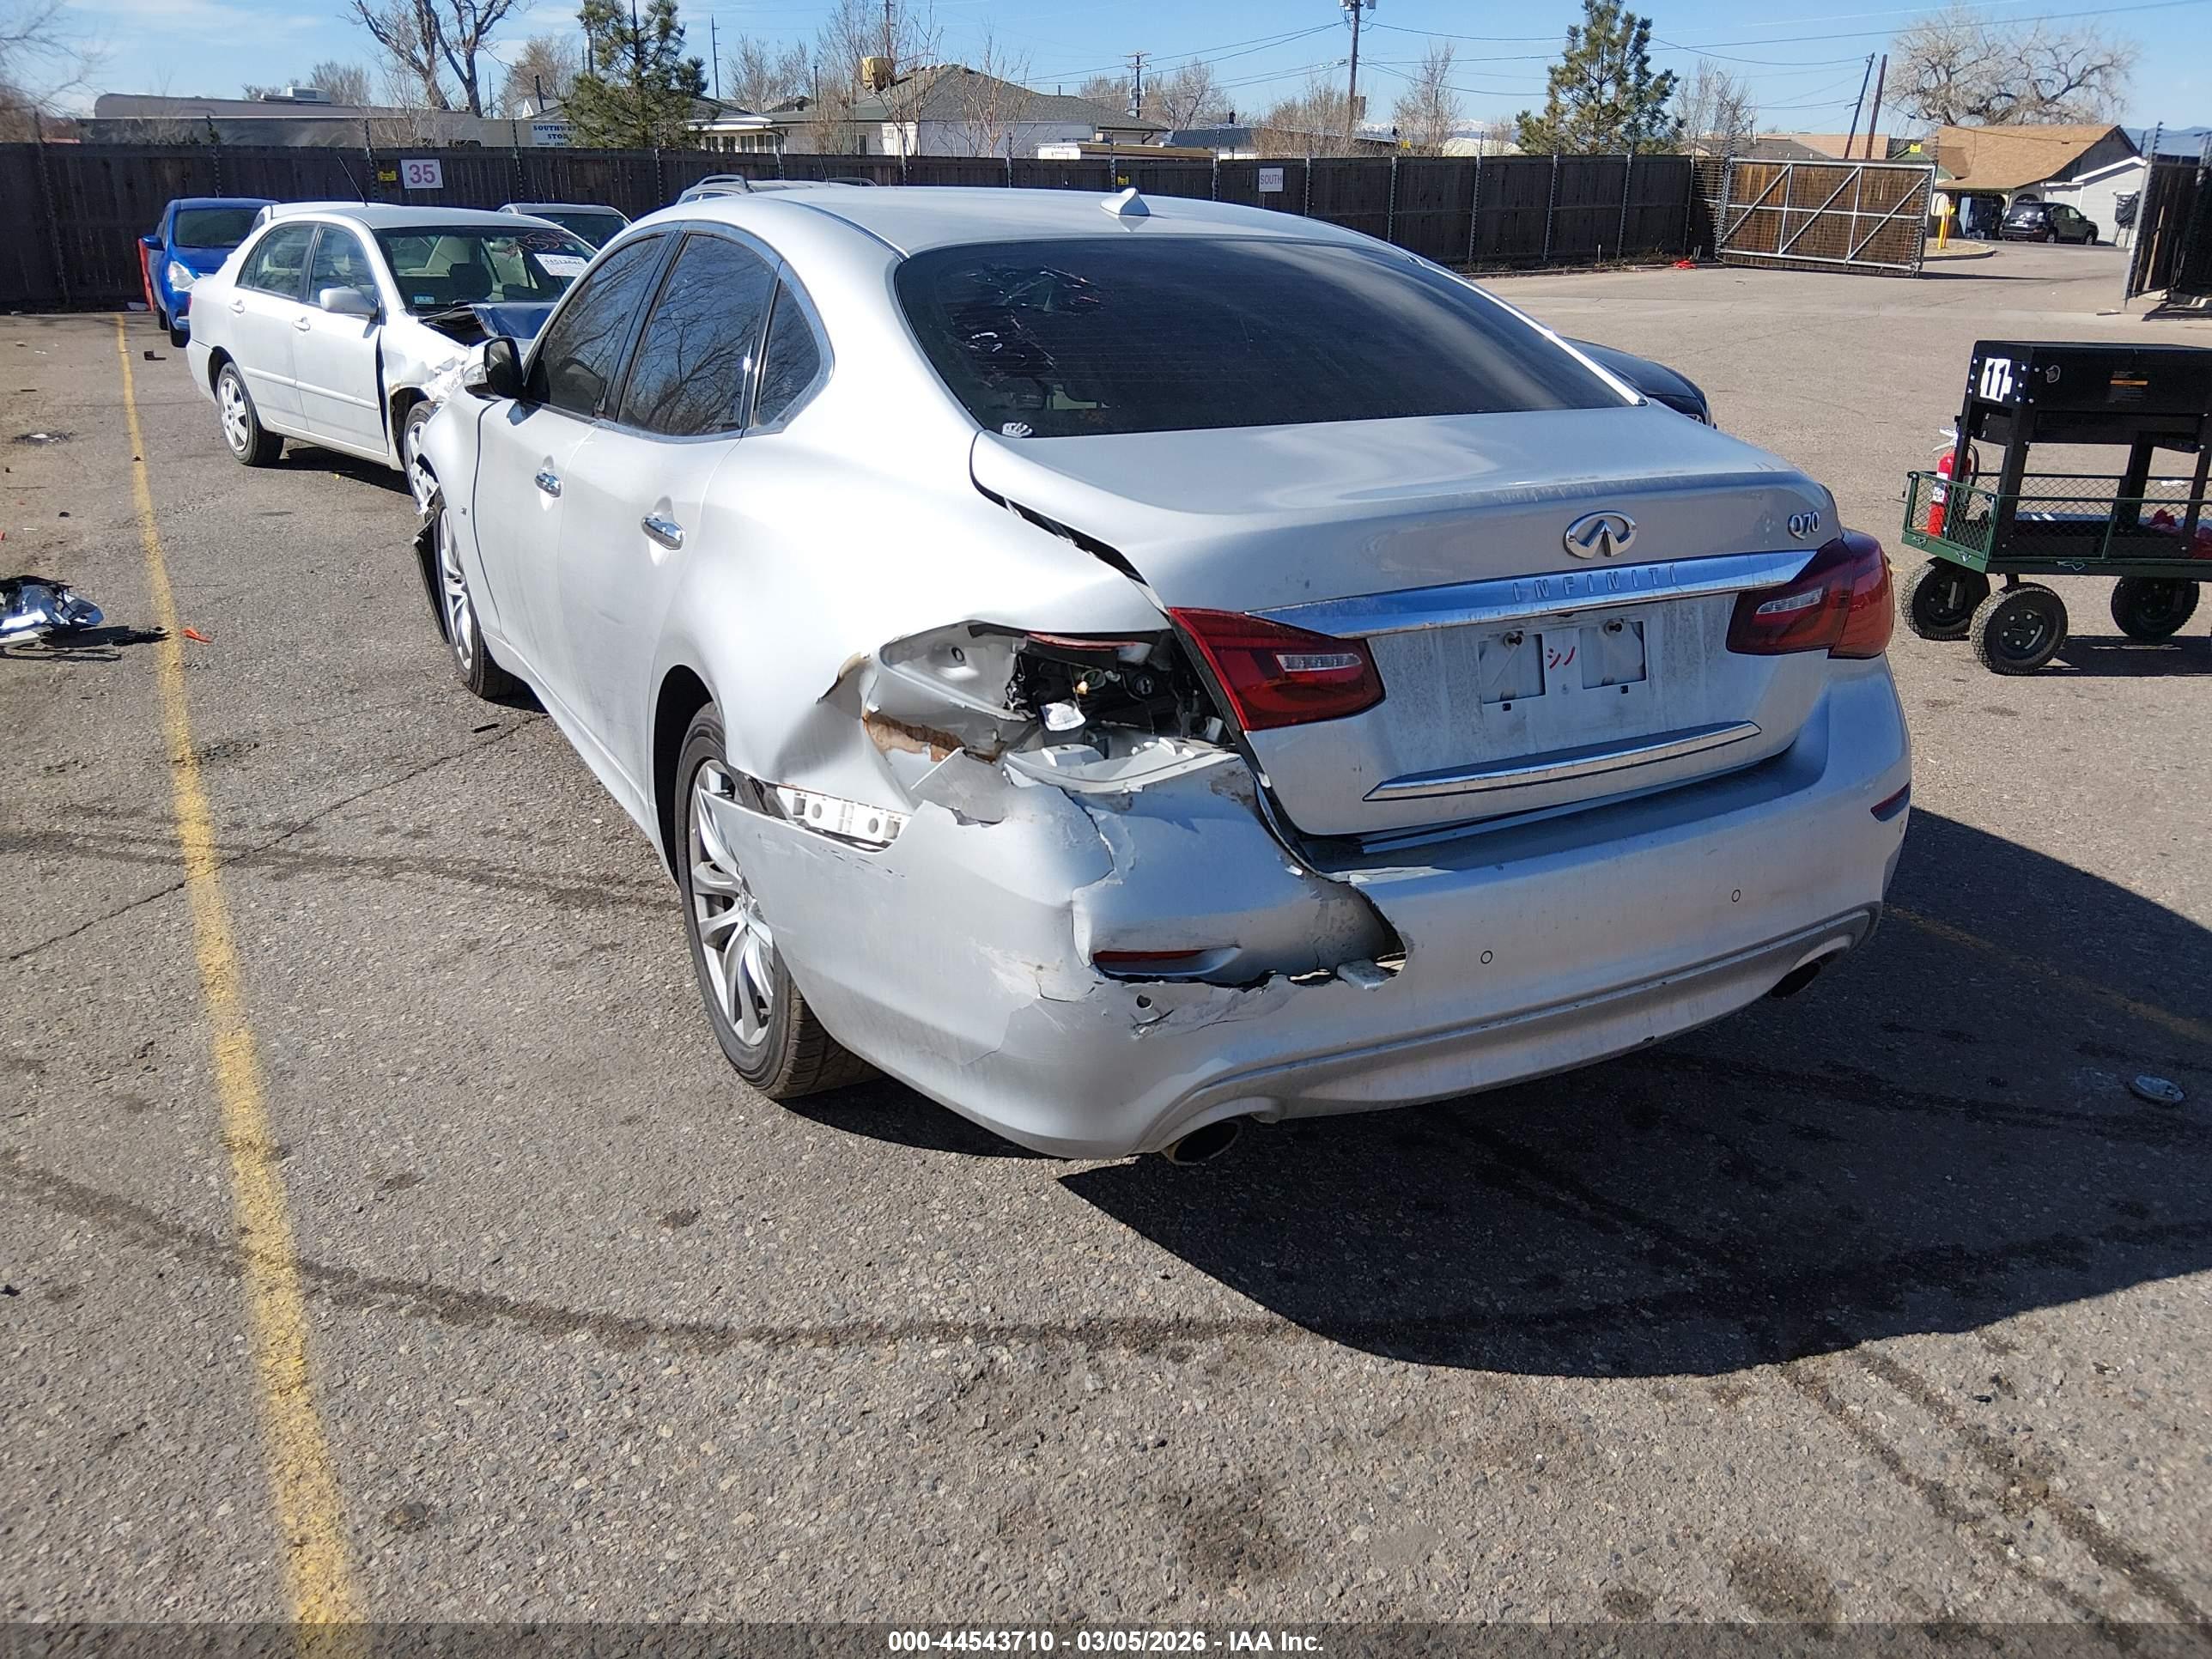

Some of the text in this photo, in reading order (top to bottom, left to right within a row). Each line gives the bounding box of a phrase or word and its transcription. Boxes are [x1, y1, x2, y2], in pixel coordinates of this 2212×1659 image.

[409, 164, 436, 184] 35
[1260, 174, 1282, 185] SOUTH
[1985, 361, 2008, 399] 11
[1788, 511, 1820, 540] Q70
[1513, 563, 1674, 600] INFINITI
